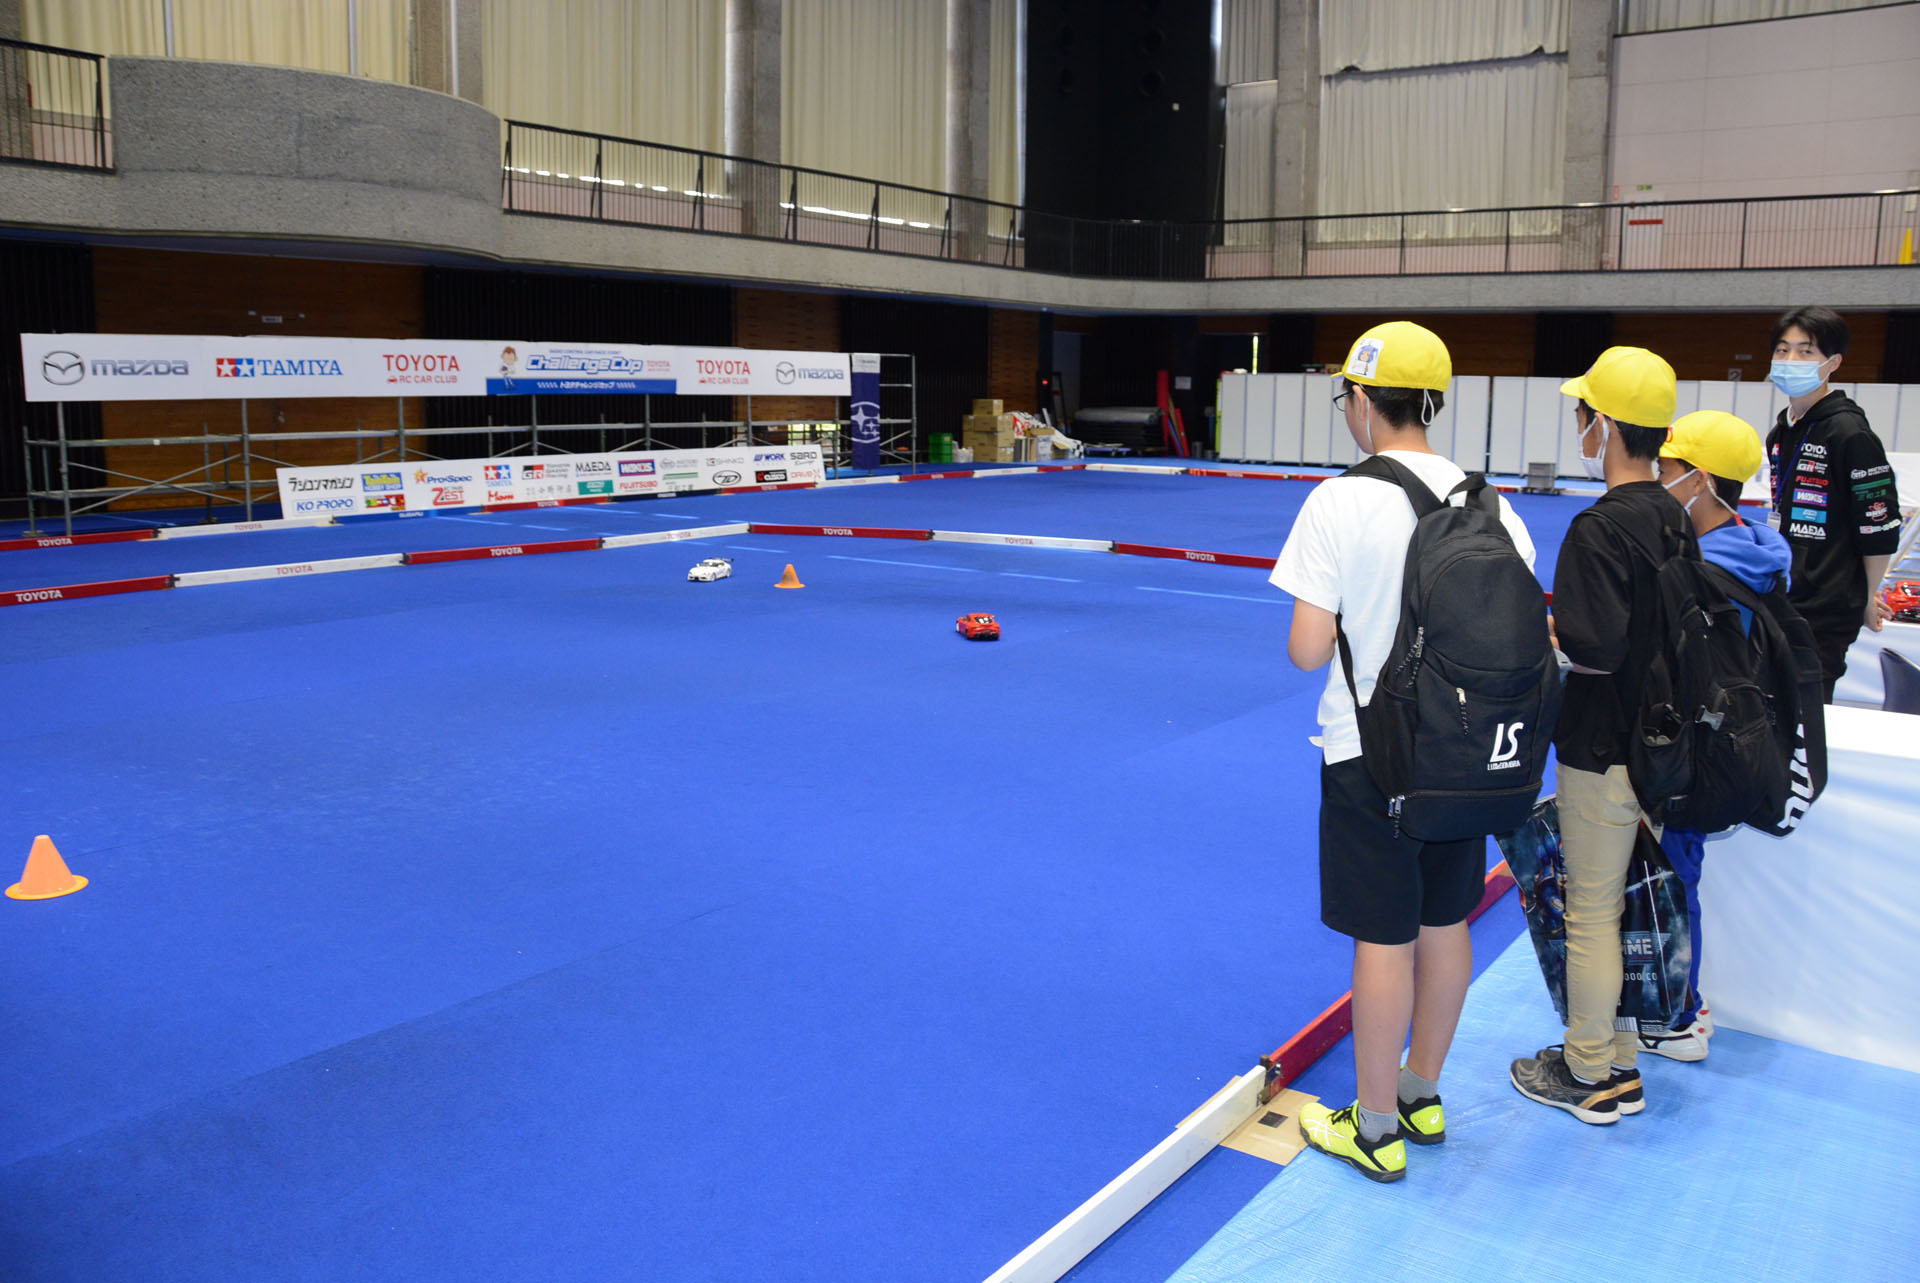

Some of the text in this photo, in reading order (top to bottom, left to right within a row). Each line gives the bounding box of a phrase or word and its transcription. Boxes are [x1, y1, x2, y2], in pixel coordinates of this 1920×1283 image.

[257, 359, 343, 376] TAMIYA
[383, 354, 460, 372] TOYOTA
[696, 360, 750, 375] TOYOTA
[399, 375, 458, 384] RC CAR CLUB
[765, 453, 785, 461] WORK
[576, 461, 611, 472] MAEDA
[620, 481, 658, 489] FUJITSUBO
[297, 501, 314, 511] KO
[316, 498, 353, 509] PROPO
[823, 528, 853, 536] TOYOTA
[1790, 523, 1826, 537] MAEDA
[37, 538, 72, 547] TOYOTA
[1004, 537, 1034, 546] TOYOTA
[490, 547, 523, 556] TOYOTA
[1185, 552, 1216, 562] TOYOTA
[277, 565, 313, 576] TOYOTA
[16, 590, 62, 602] TOYOTA
